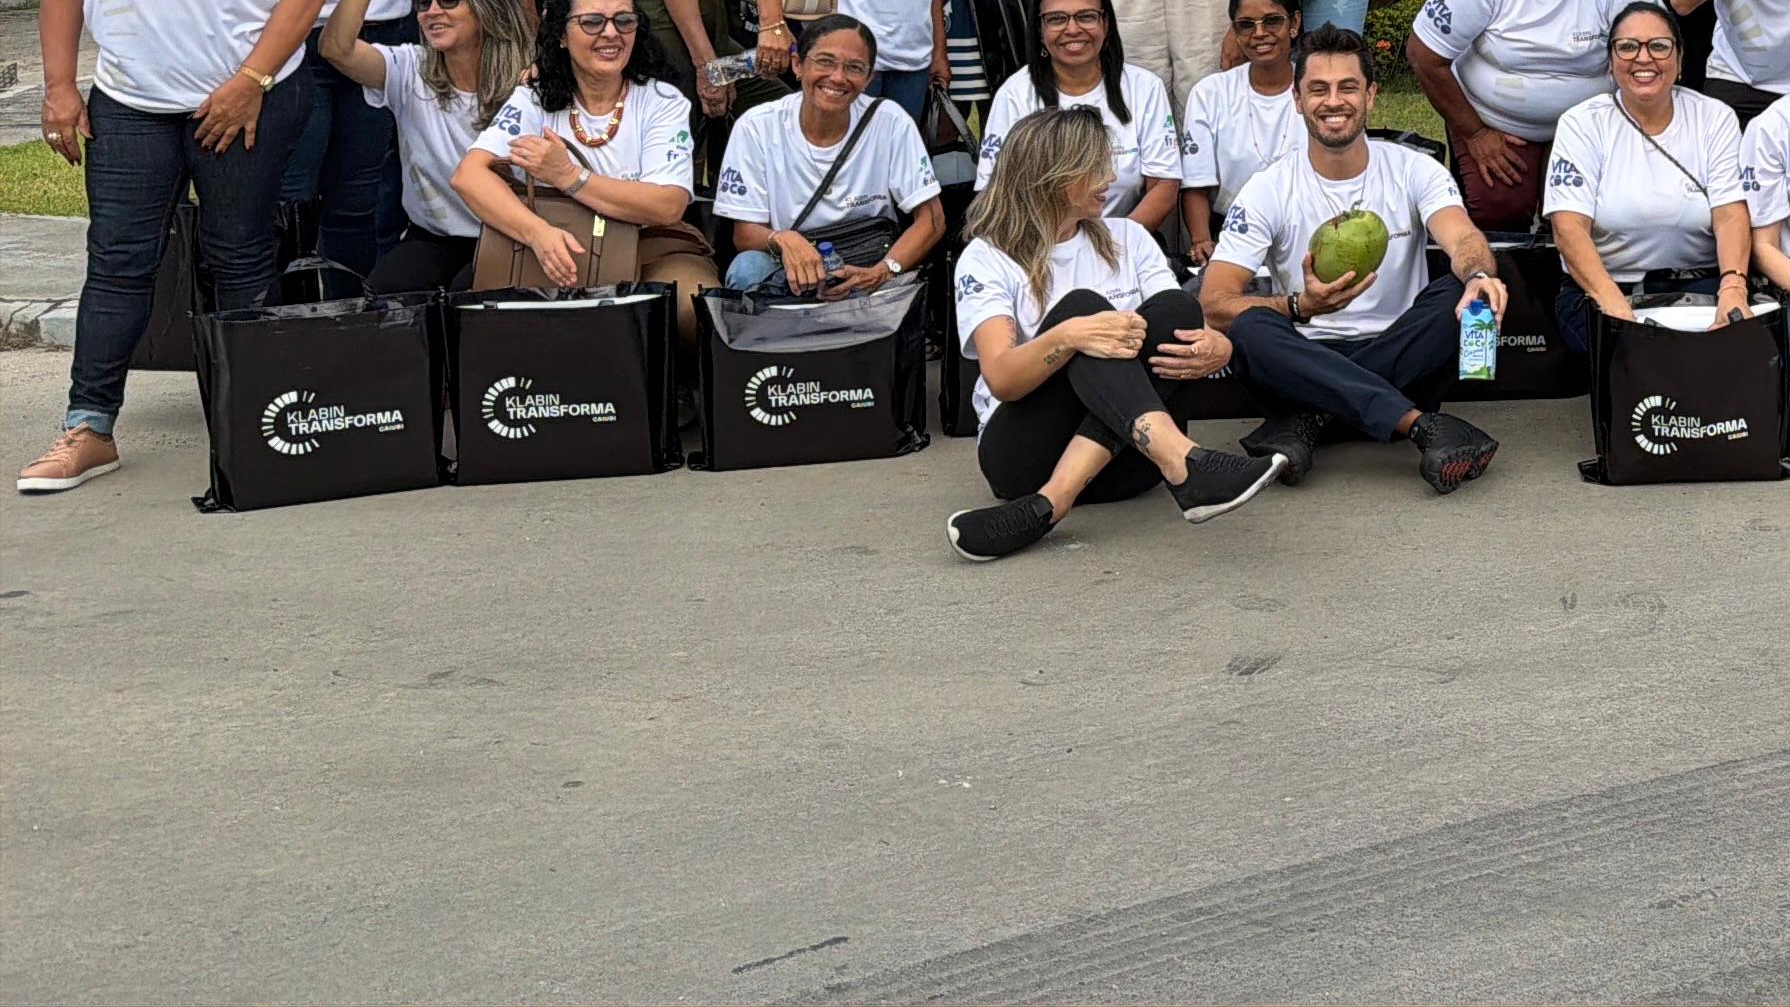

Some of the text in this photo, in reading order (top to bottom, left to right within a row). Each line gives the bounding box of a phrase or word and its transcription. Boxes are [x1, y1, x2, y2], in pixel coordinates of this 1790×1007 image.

[1552, 157, 1581, 175] VITA
[720, 181, 747, 196] OCO
[1106, 288, 1140, 301] ANSFORMA
[1464, 330, 1485, 340] VITA
[1496, 335, 1546, 347] SFORMA
[768, 380, 821, 397] KLABIN
[506, 393, 560, 408] KLABIN
[768, 388, 875, 408] TRANSFORMA
[287, 404, 345, 424] KLABIN
[507, 401, 617, 422] TRANSFORMA
[288, 409, 404, 436] TRANSFORMA
[1651, 413, 1701, 429] KLABIN
[1653, 417, 1748, 439] TRANSFORMA
